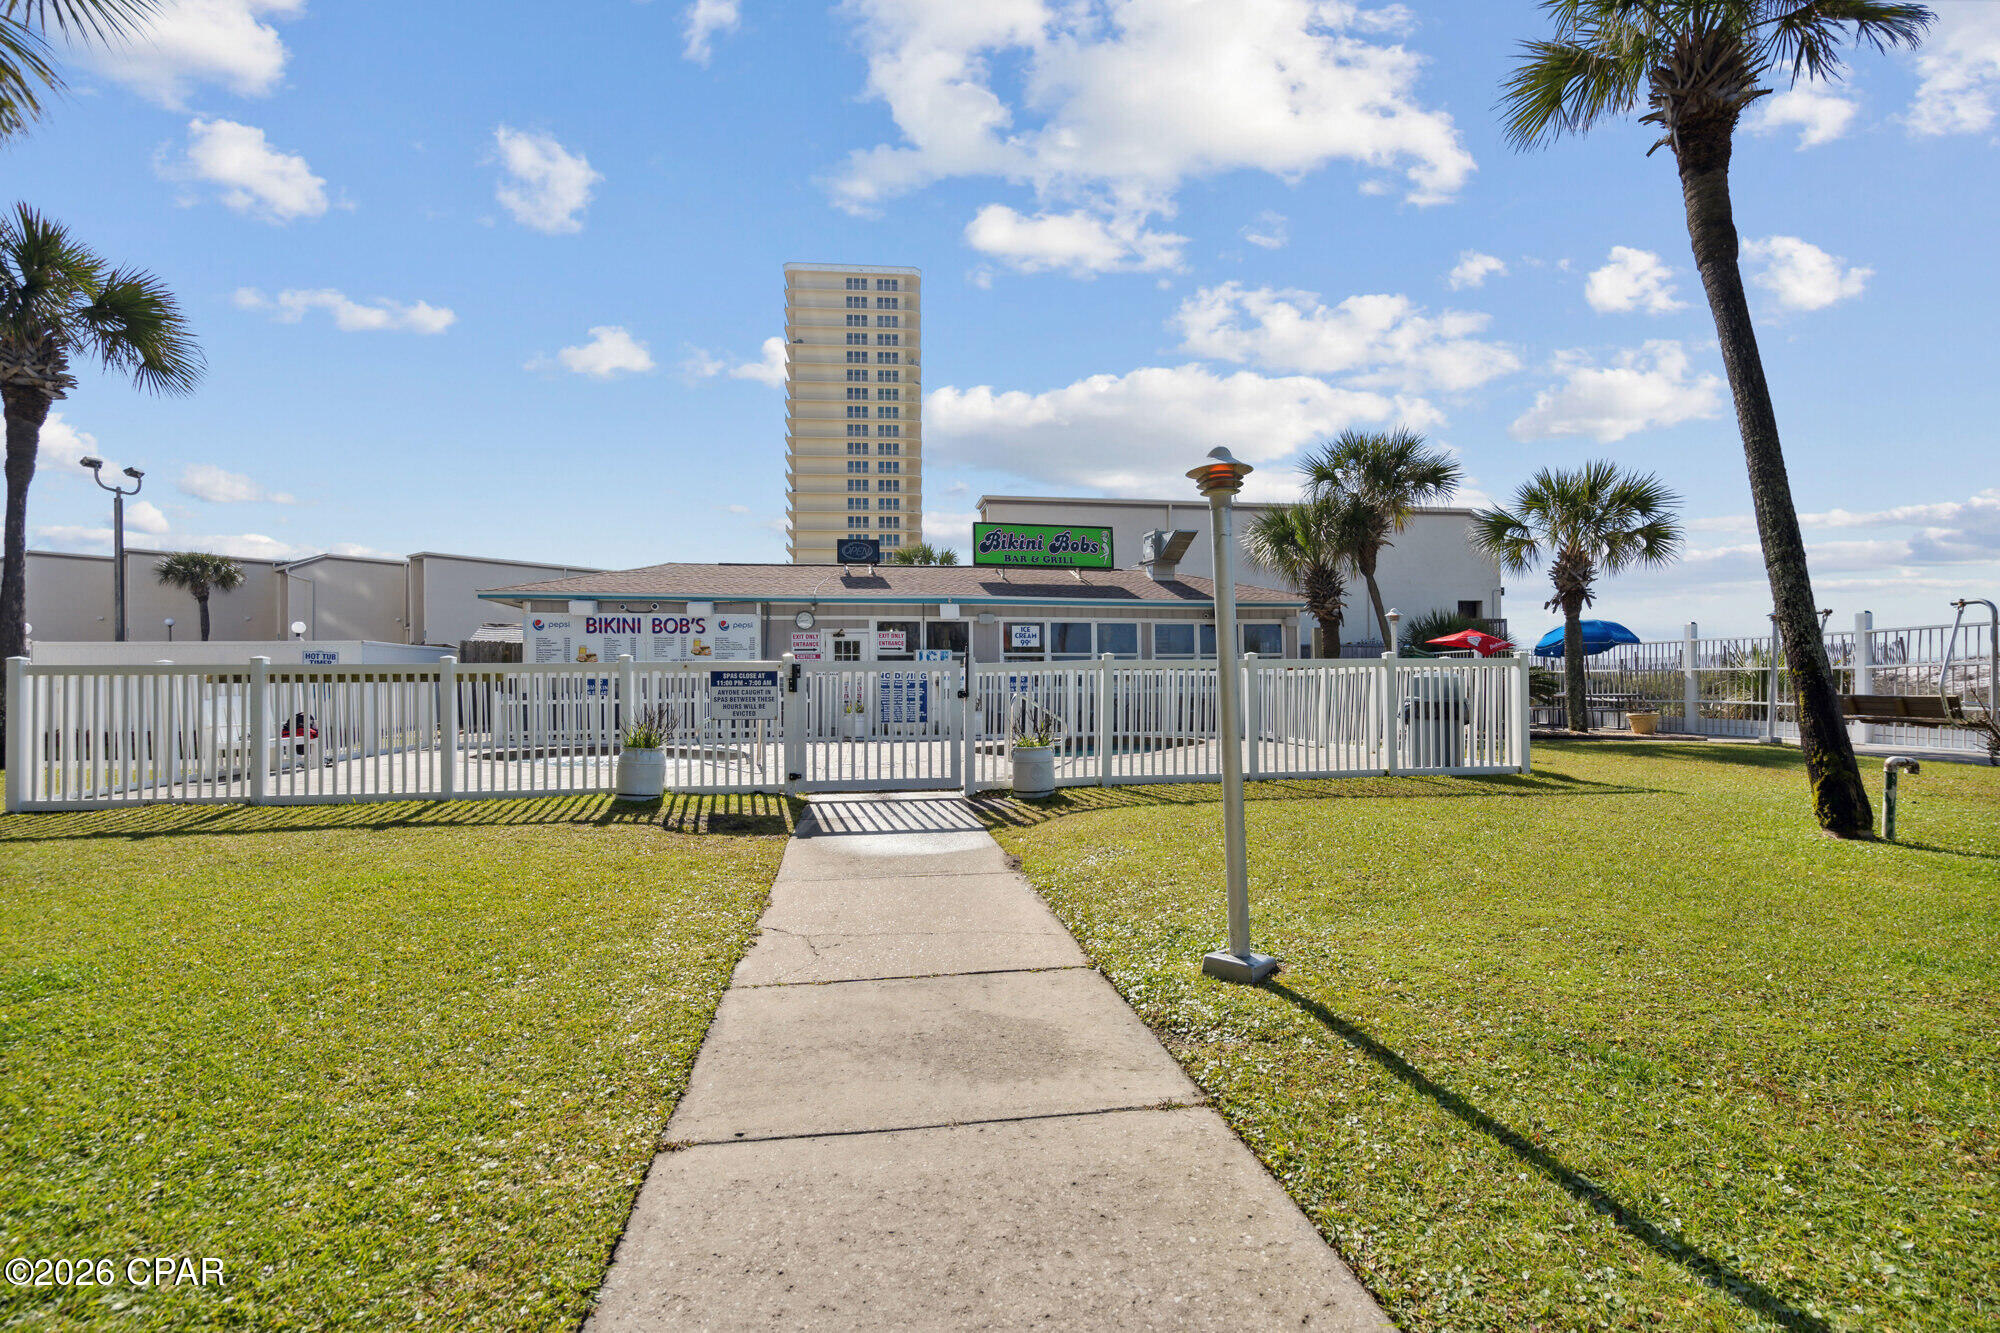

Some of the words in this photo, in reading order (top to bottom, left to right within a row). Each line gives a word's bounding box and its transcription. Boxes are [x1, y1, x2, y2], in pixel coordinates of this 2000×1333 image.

[979, 528, 1045, 554] Bikini
[1004, 555, 1027, 563] BAR
[1043, 555, 1074, 564] GRILL
[548, 621, 570, 629] pepsi
[585, 617, 641, 634] BIKINI
[652, 617, 706, 634] BOB'S
[733, 622, 753, 630] pepsi
